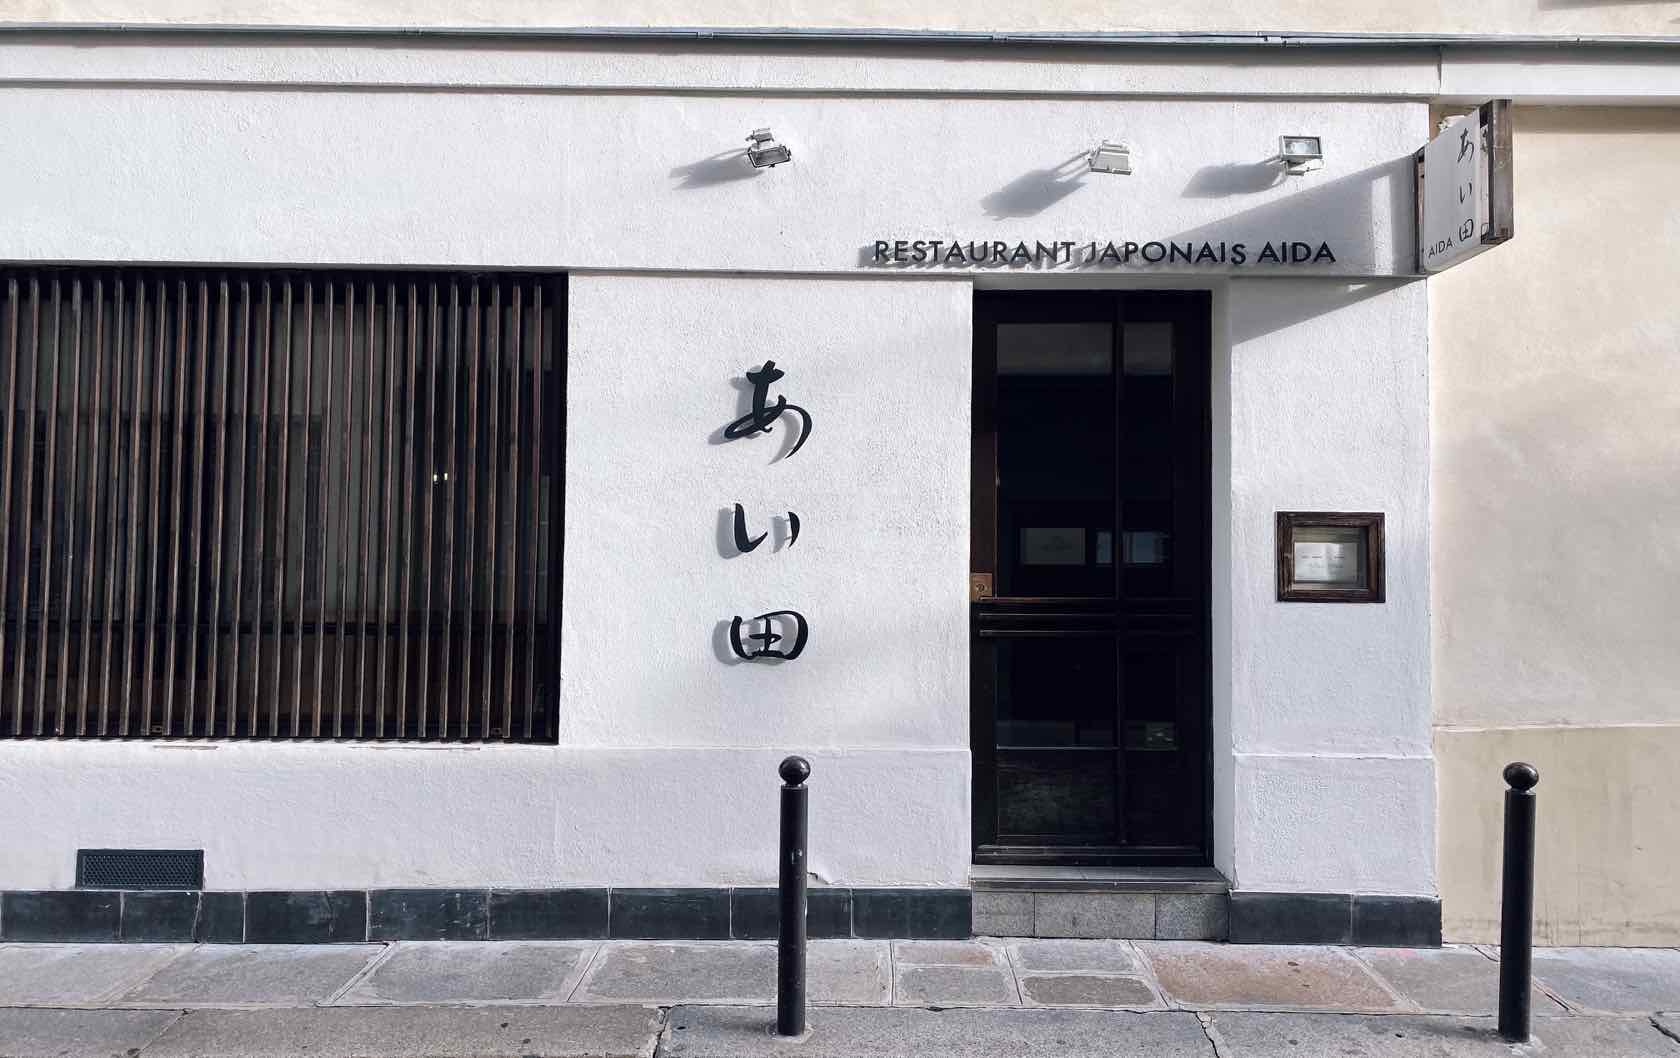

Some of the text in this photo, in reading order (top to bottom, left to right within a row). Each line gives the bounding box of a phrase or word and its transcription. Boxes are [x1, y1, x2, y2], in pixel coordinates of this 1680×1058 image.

[1457, 127, 1475, 243] あい田
[874, 240, 1337, 266] RESTAURANT JAPONAIS AIDA
[1427, 237, 1454, 259] AIDA
[723, 360, 813, 661] あい田
